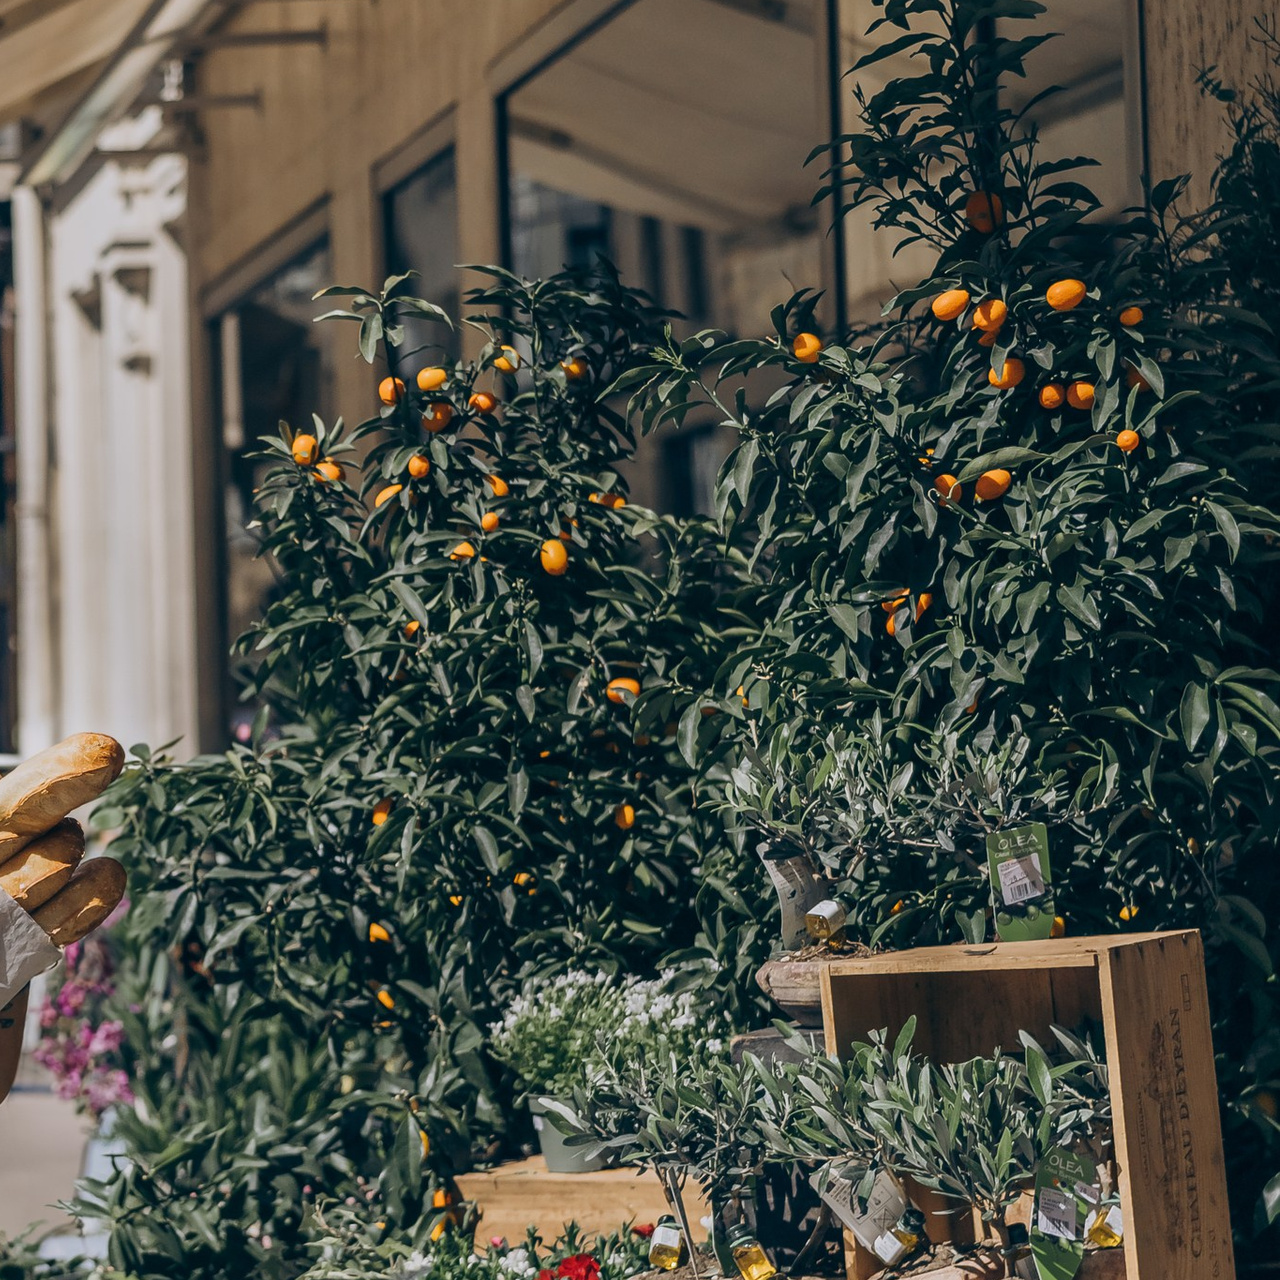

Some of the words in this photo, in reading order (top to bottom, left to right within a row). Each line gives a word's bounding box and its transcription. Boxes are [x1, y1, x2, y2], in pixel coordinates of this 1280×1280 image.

[997, 832, 1038, 850] OLEA
[1168, 1005, 1190, 1121] D'EYRAN
[1049, 1154, 1084, 1177] OLEA
